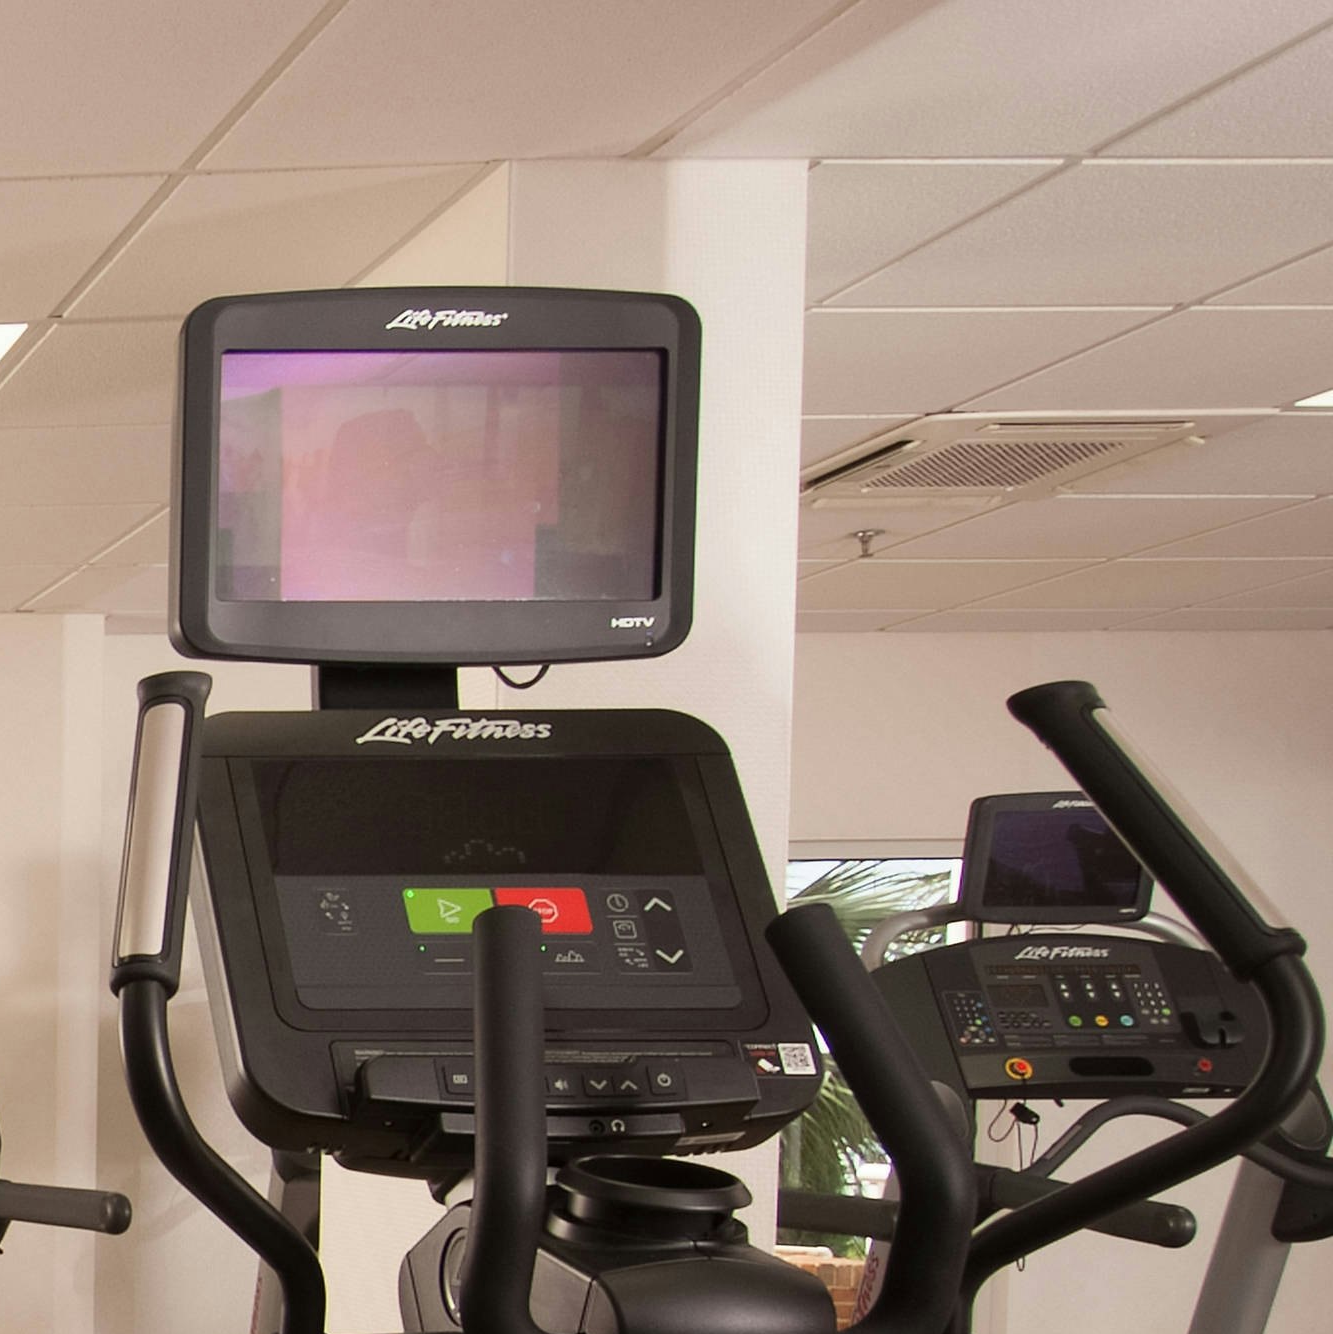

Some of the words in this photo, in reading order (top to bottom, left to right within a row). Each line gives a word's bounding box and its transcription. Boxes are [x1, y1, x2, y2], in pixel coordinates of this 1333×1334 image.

[428, 309, 501, 331] Fitness
[611, 616, 655, 628] HDTV
[355, 716, 432, 744] Life
[428, 717, 552, 744] Fitness
